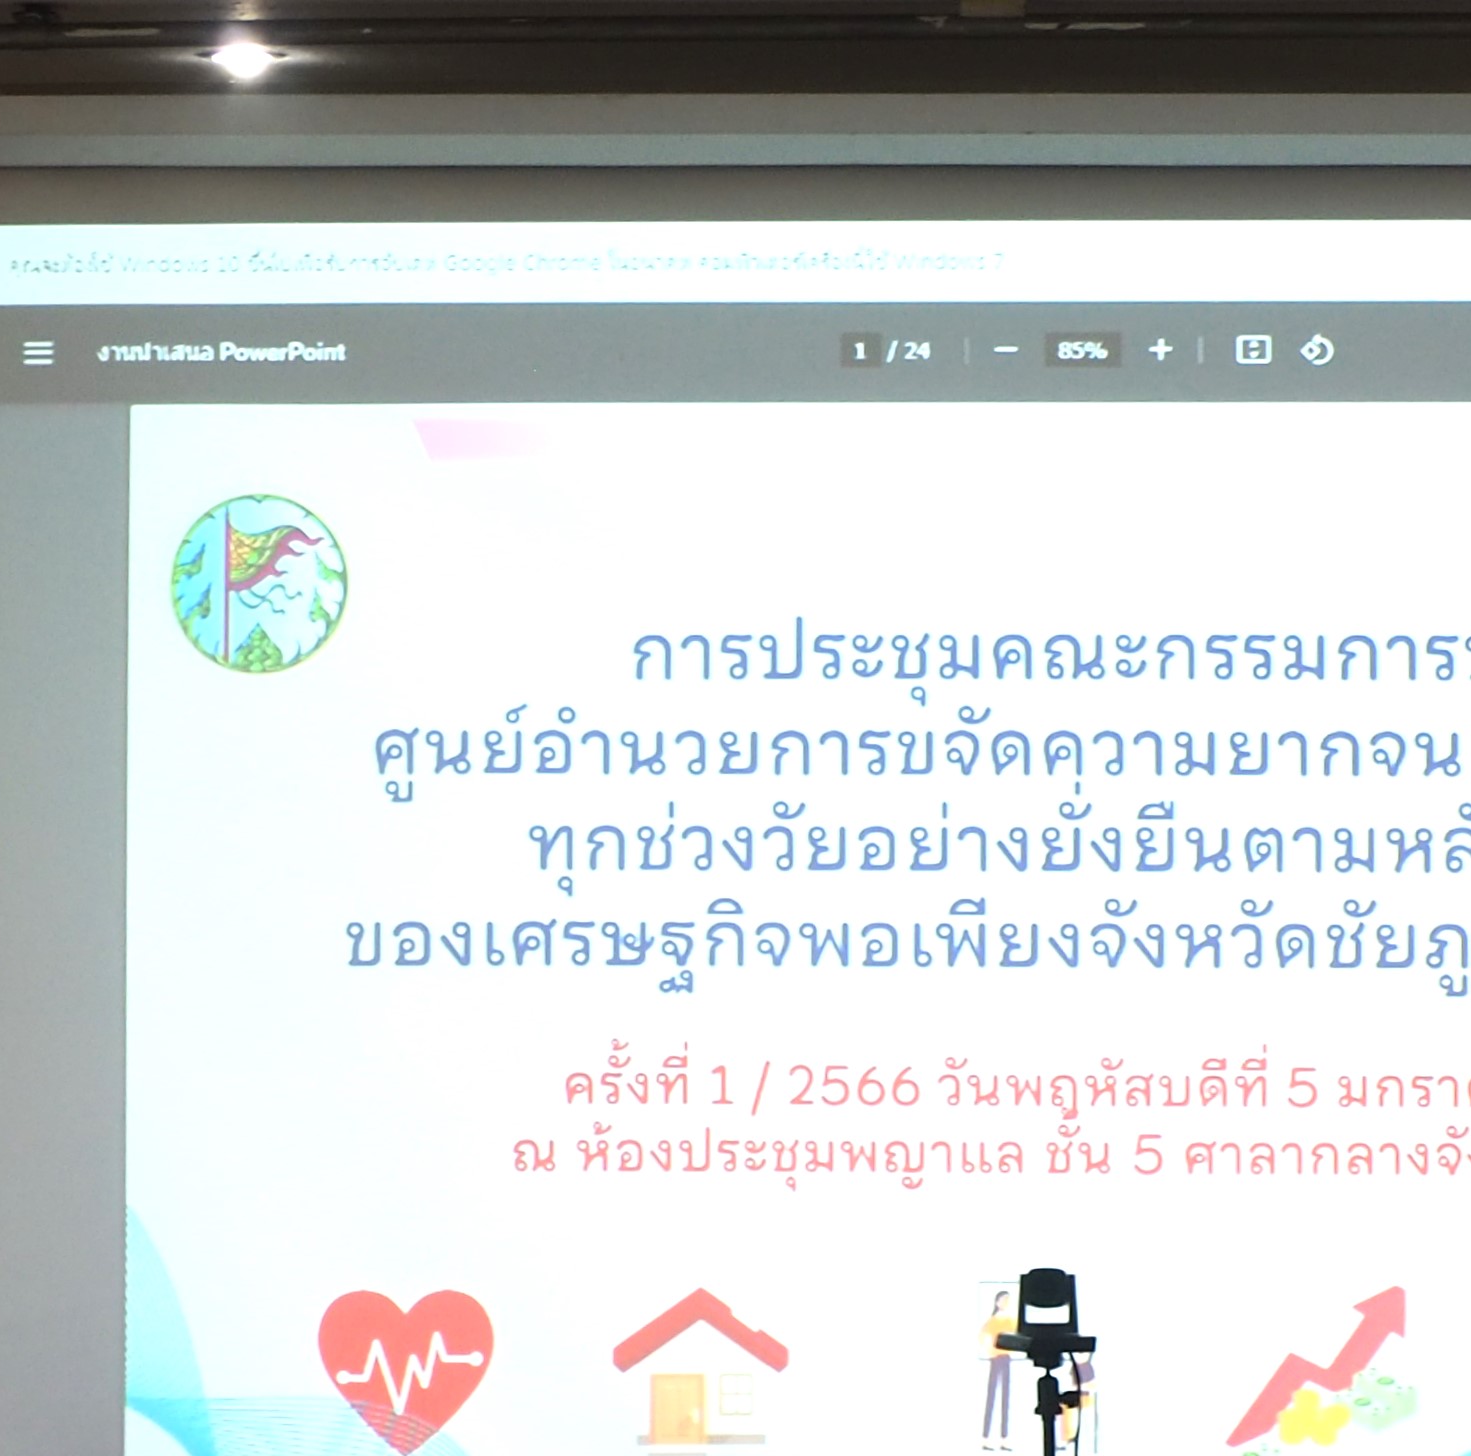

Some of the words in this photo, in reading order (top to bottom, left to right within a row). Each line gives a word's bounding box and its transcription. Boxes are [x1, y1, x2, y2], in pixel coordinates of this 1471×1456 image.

[442, 253, 515, 276] Google
[522, 253, 602, 272] Chrome
[219, 341, 347, 361] PowerPoint
[854, 341, 867, 360] 1
[902, 341, 932, 361] 24
[1057, 340, 1109, 360] 85%
[565, 1039, 689, 1105] ครั้งที่
[712, 1065, 732, 1105] 1
[751, 1061, 770, 1116] /
[789, 1064, 920, 1107] 2566
[939, 1044, 1268, 1119] วันพฤหัสบดีที่
[1288, 1067, 1318, 1109] 5
[513, 1138, 556, 1172] ณ
[576, 1121, 1024, 1191] ห้องประชุมพญาแล
[1135, 1133, 1163, 1176] 5
